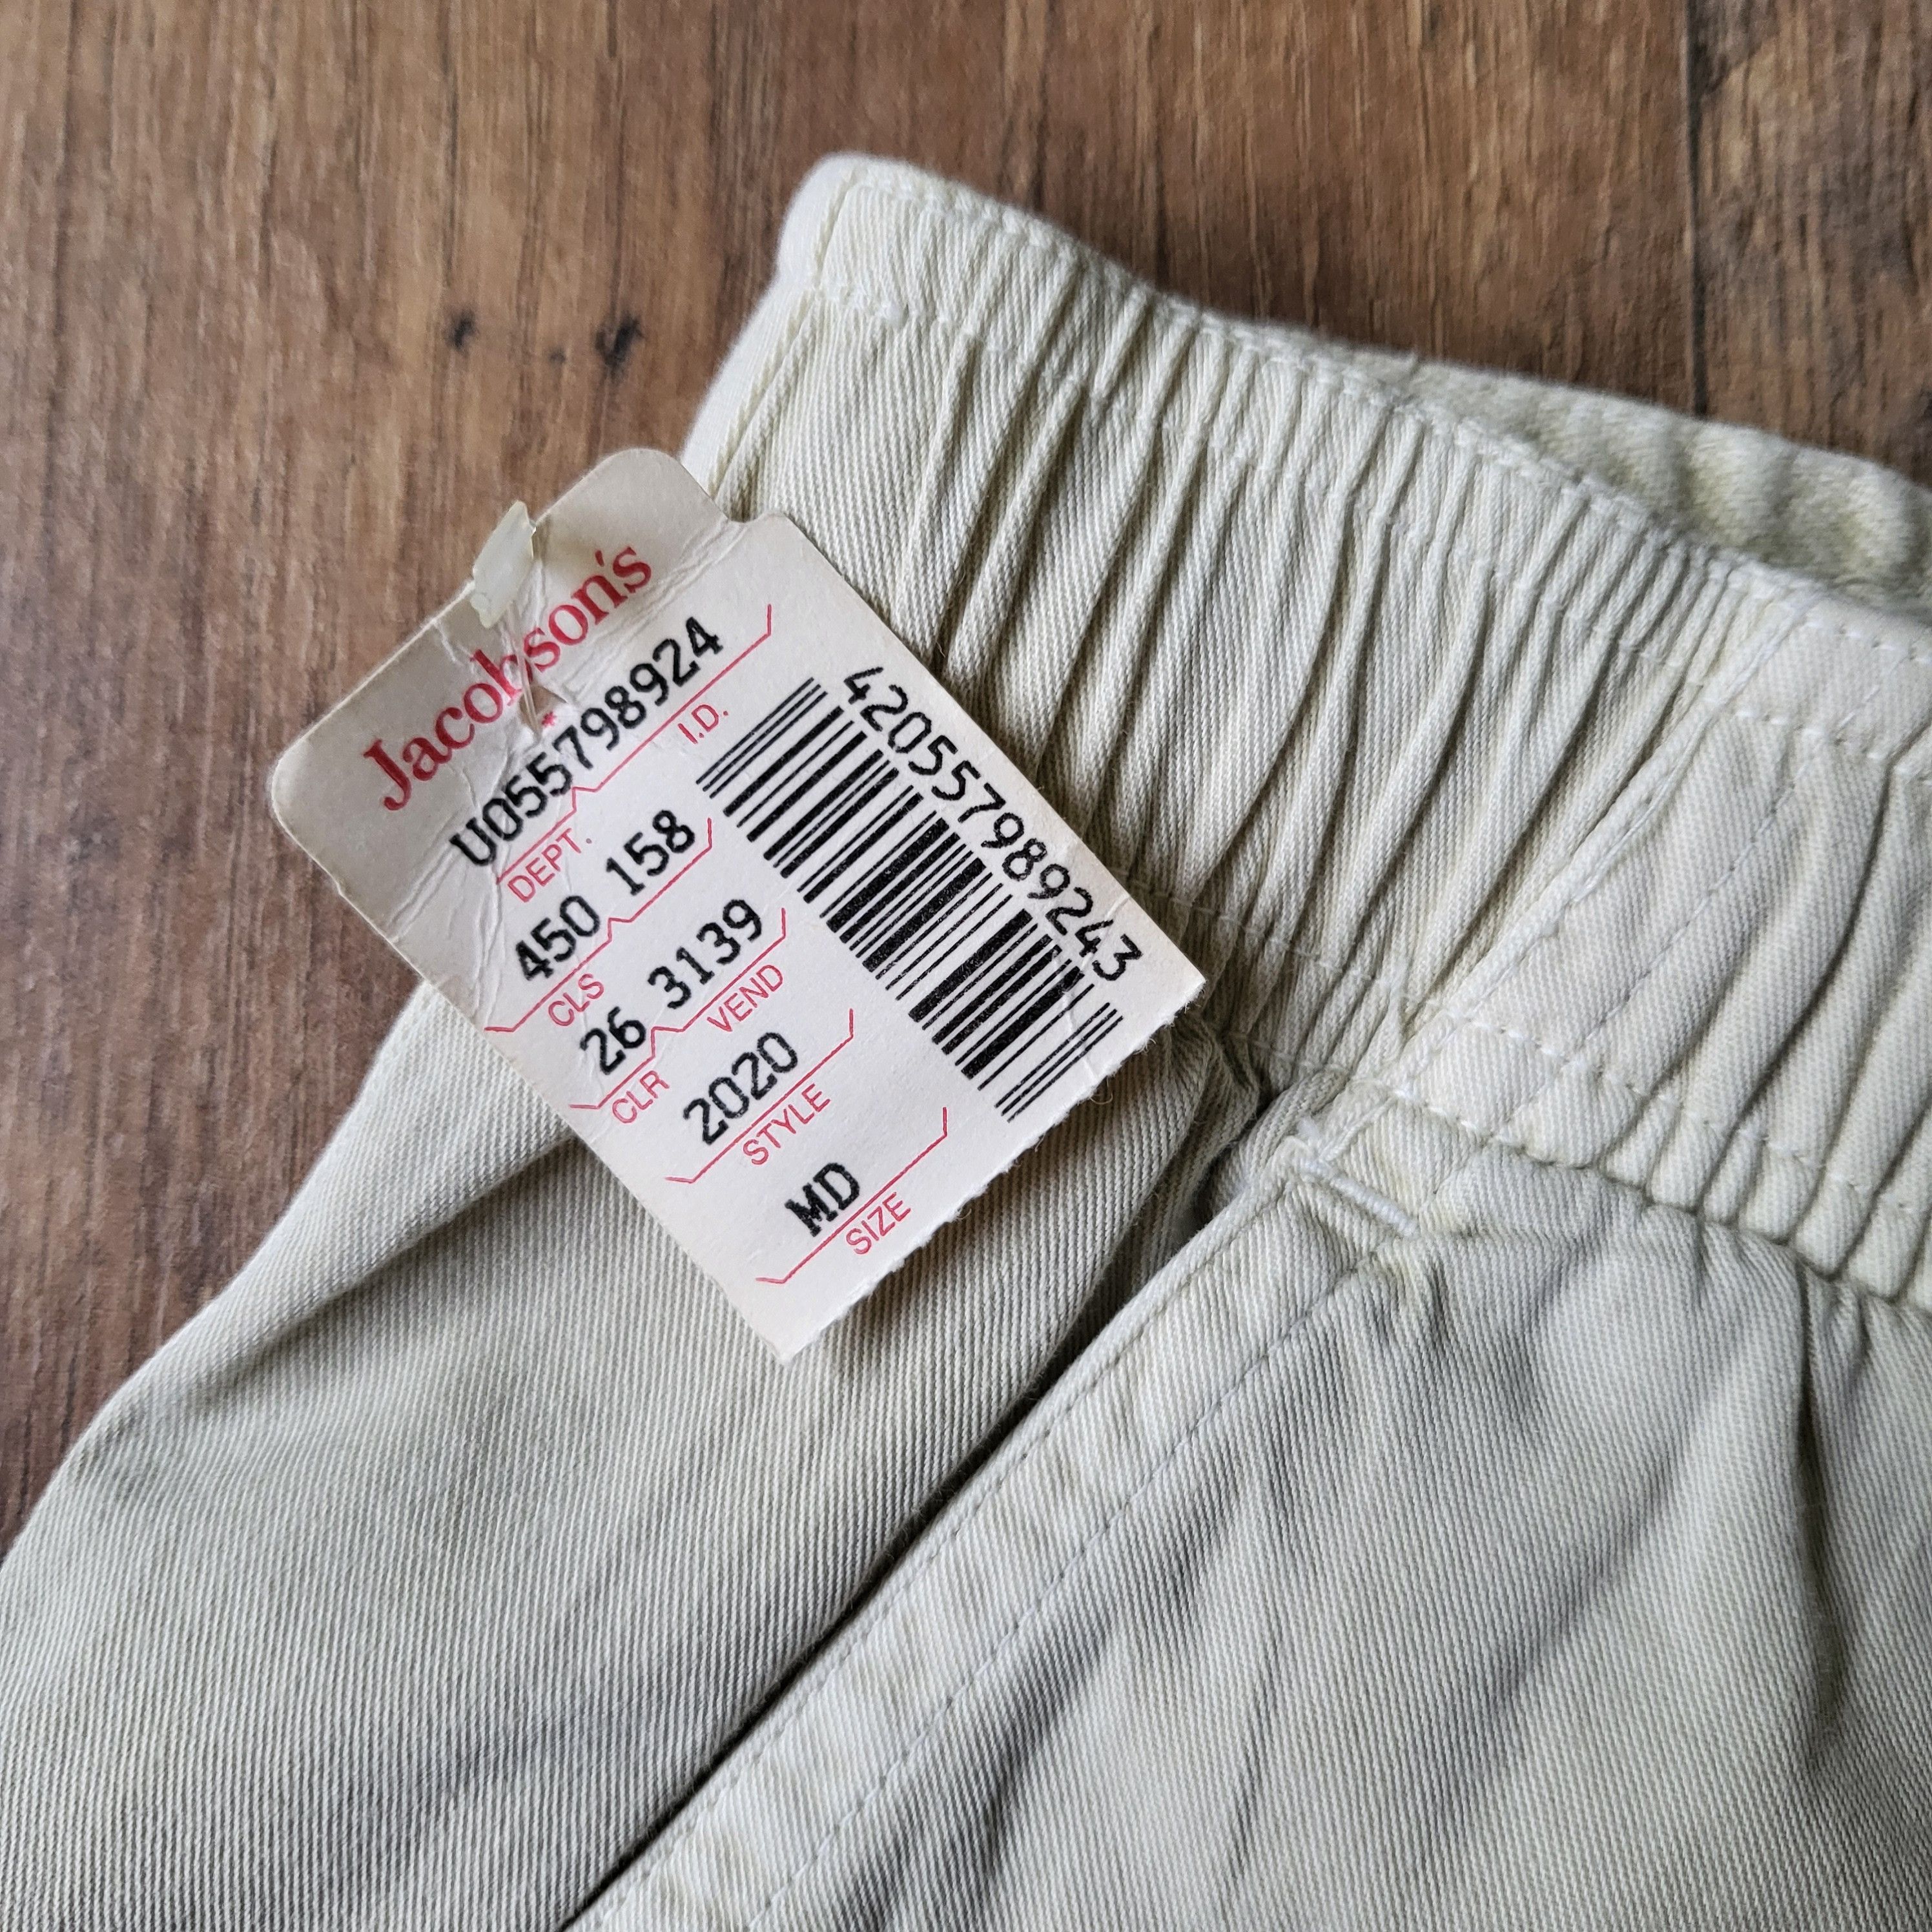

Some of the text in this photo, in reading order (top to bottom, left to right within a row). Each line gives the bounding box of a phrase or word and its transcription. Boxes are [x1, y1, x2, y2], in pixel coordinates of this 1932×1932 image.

[364, 546, 652, 810] Jacobson's
[450, 617, 723, 867] U055798924
[677, 704, 729, 745] I.D.
[844, 667, 1142, 981] 420557989243
[516, 810, 695, 981] 450 158
[548, 974, 605, 1027] CLS
[580, 899, 763, 1074] 26 3139
[707, 965, 784, 1031] VEND
[611, 1070, 670, 1124] CLR
[683, 1033, 798, 1145] 2020
[743, 1084, 831, 1165] STYLE
[785, 1162, 861, 1237] MD
[846, 1193, 911, 1255] SIZE
